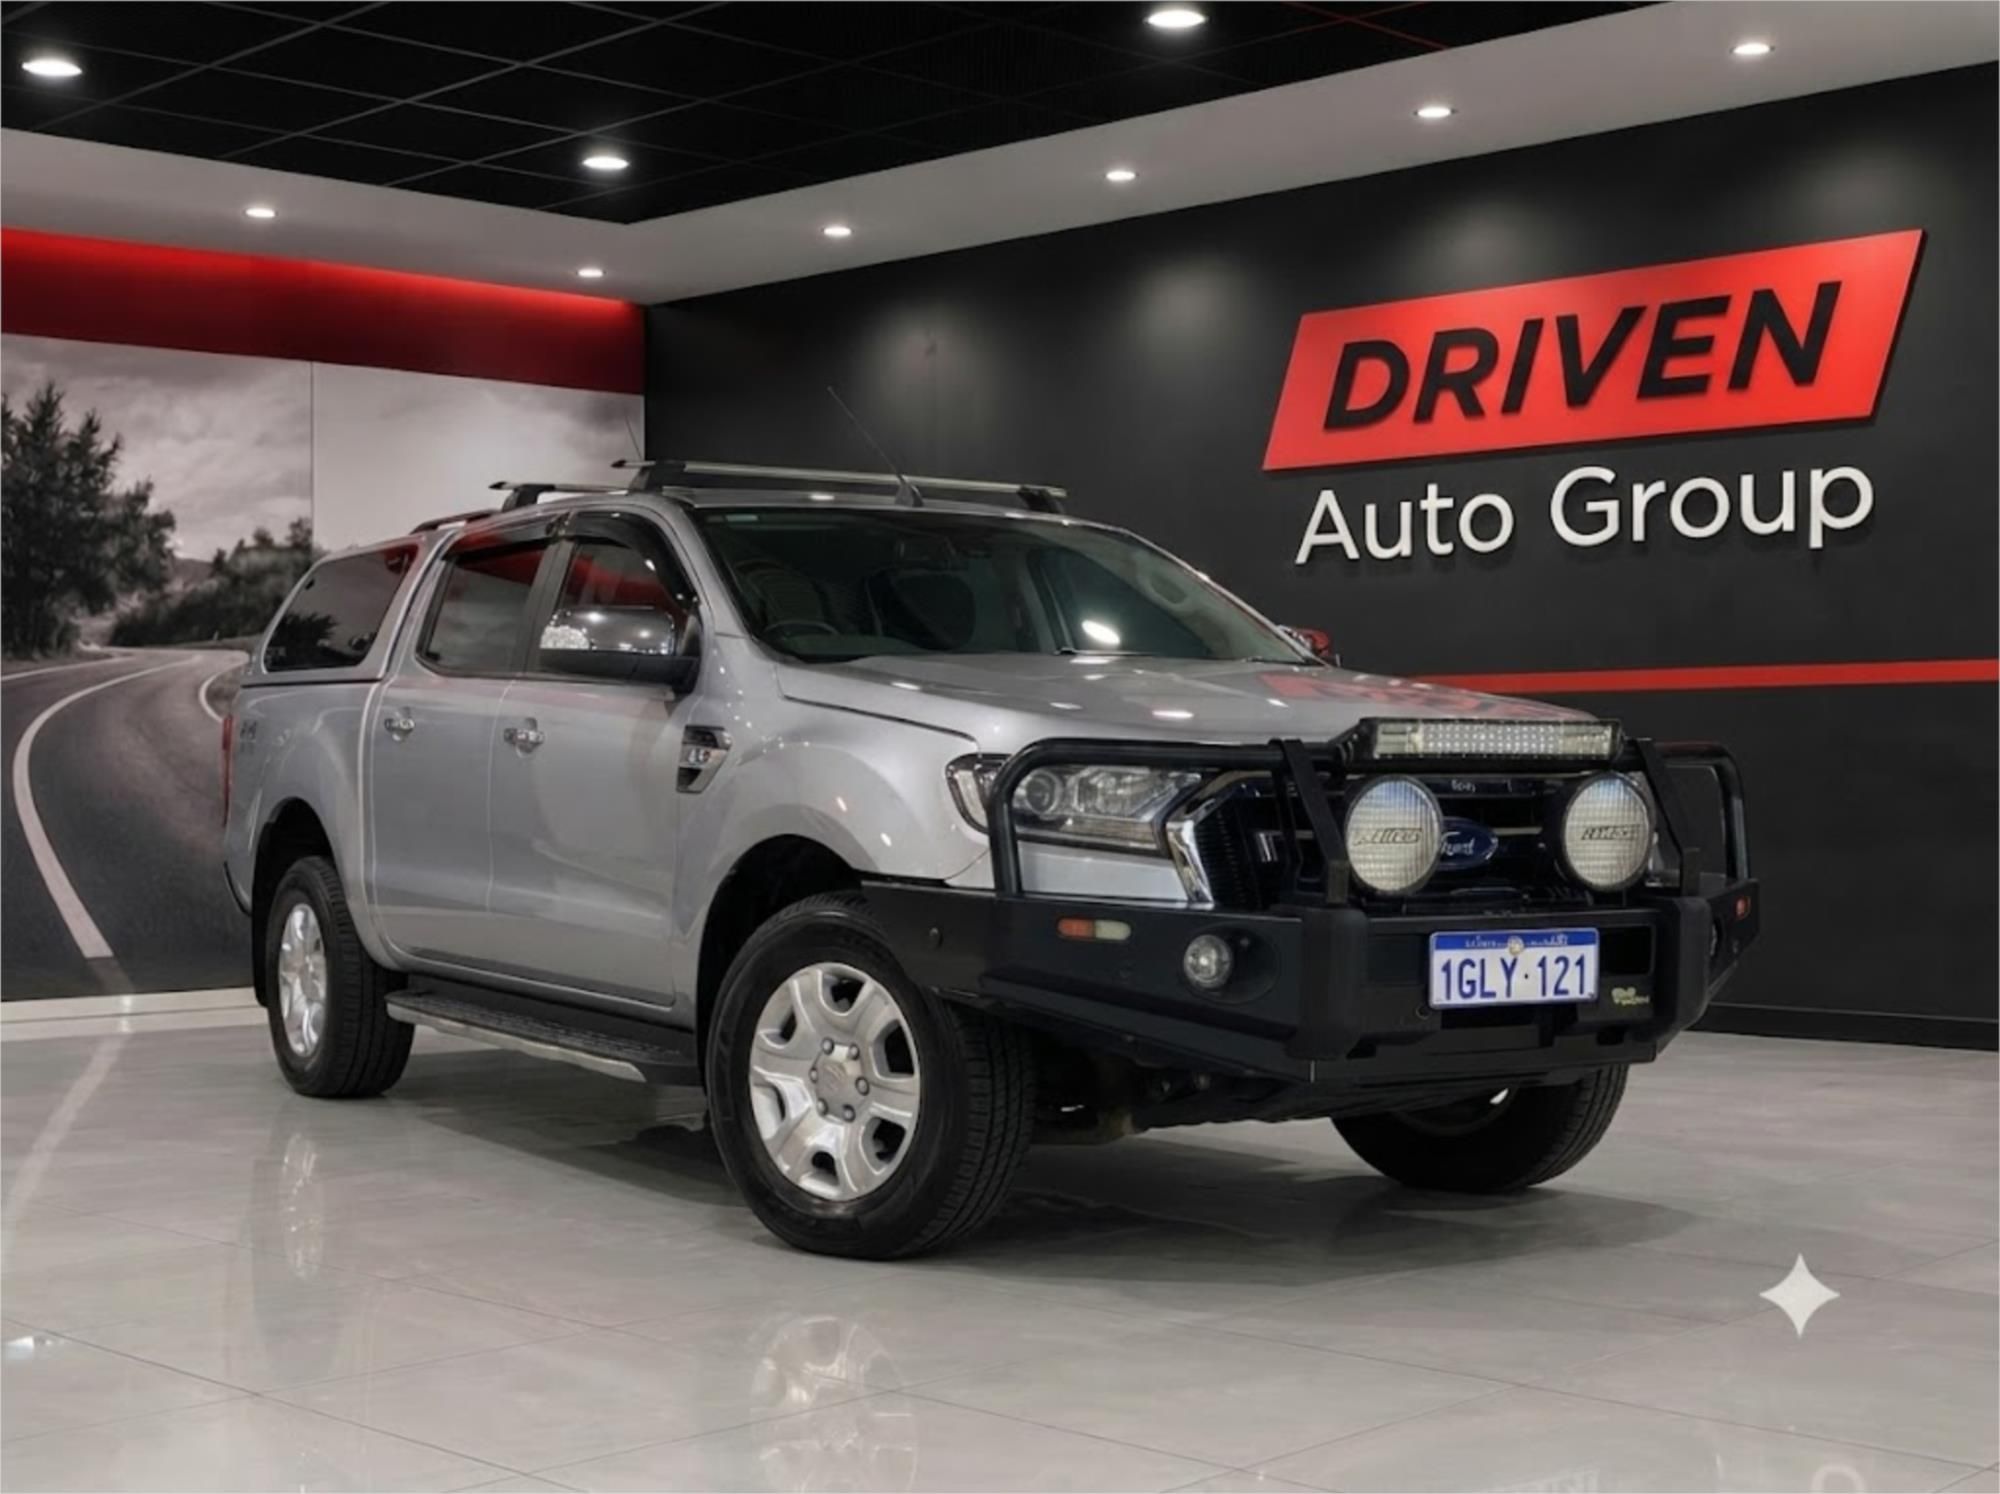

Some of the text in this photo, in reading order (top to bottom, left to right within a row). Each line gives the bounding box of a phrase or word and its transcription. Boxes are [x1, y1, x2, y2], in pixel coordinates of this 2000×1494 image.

[1324, 281, 1842, 432] DRIVEN
[1296, 466, 1875, 564] Auto Group
